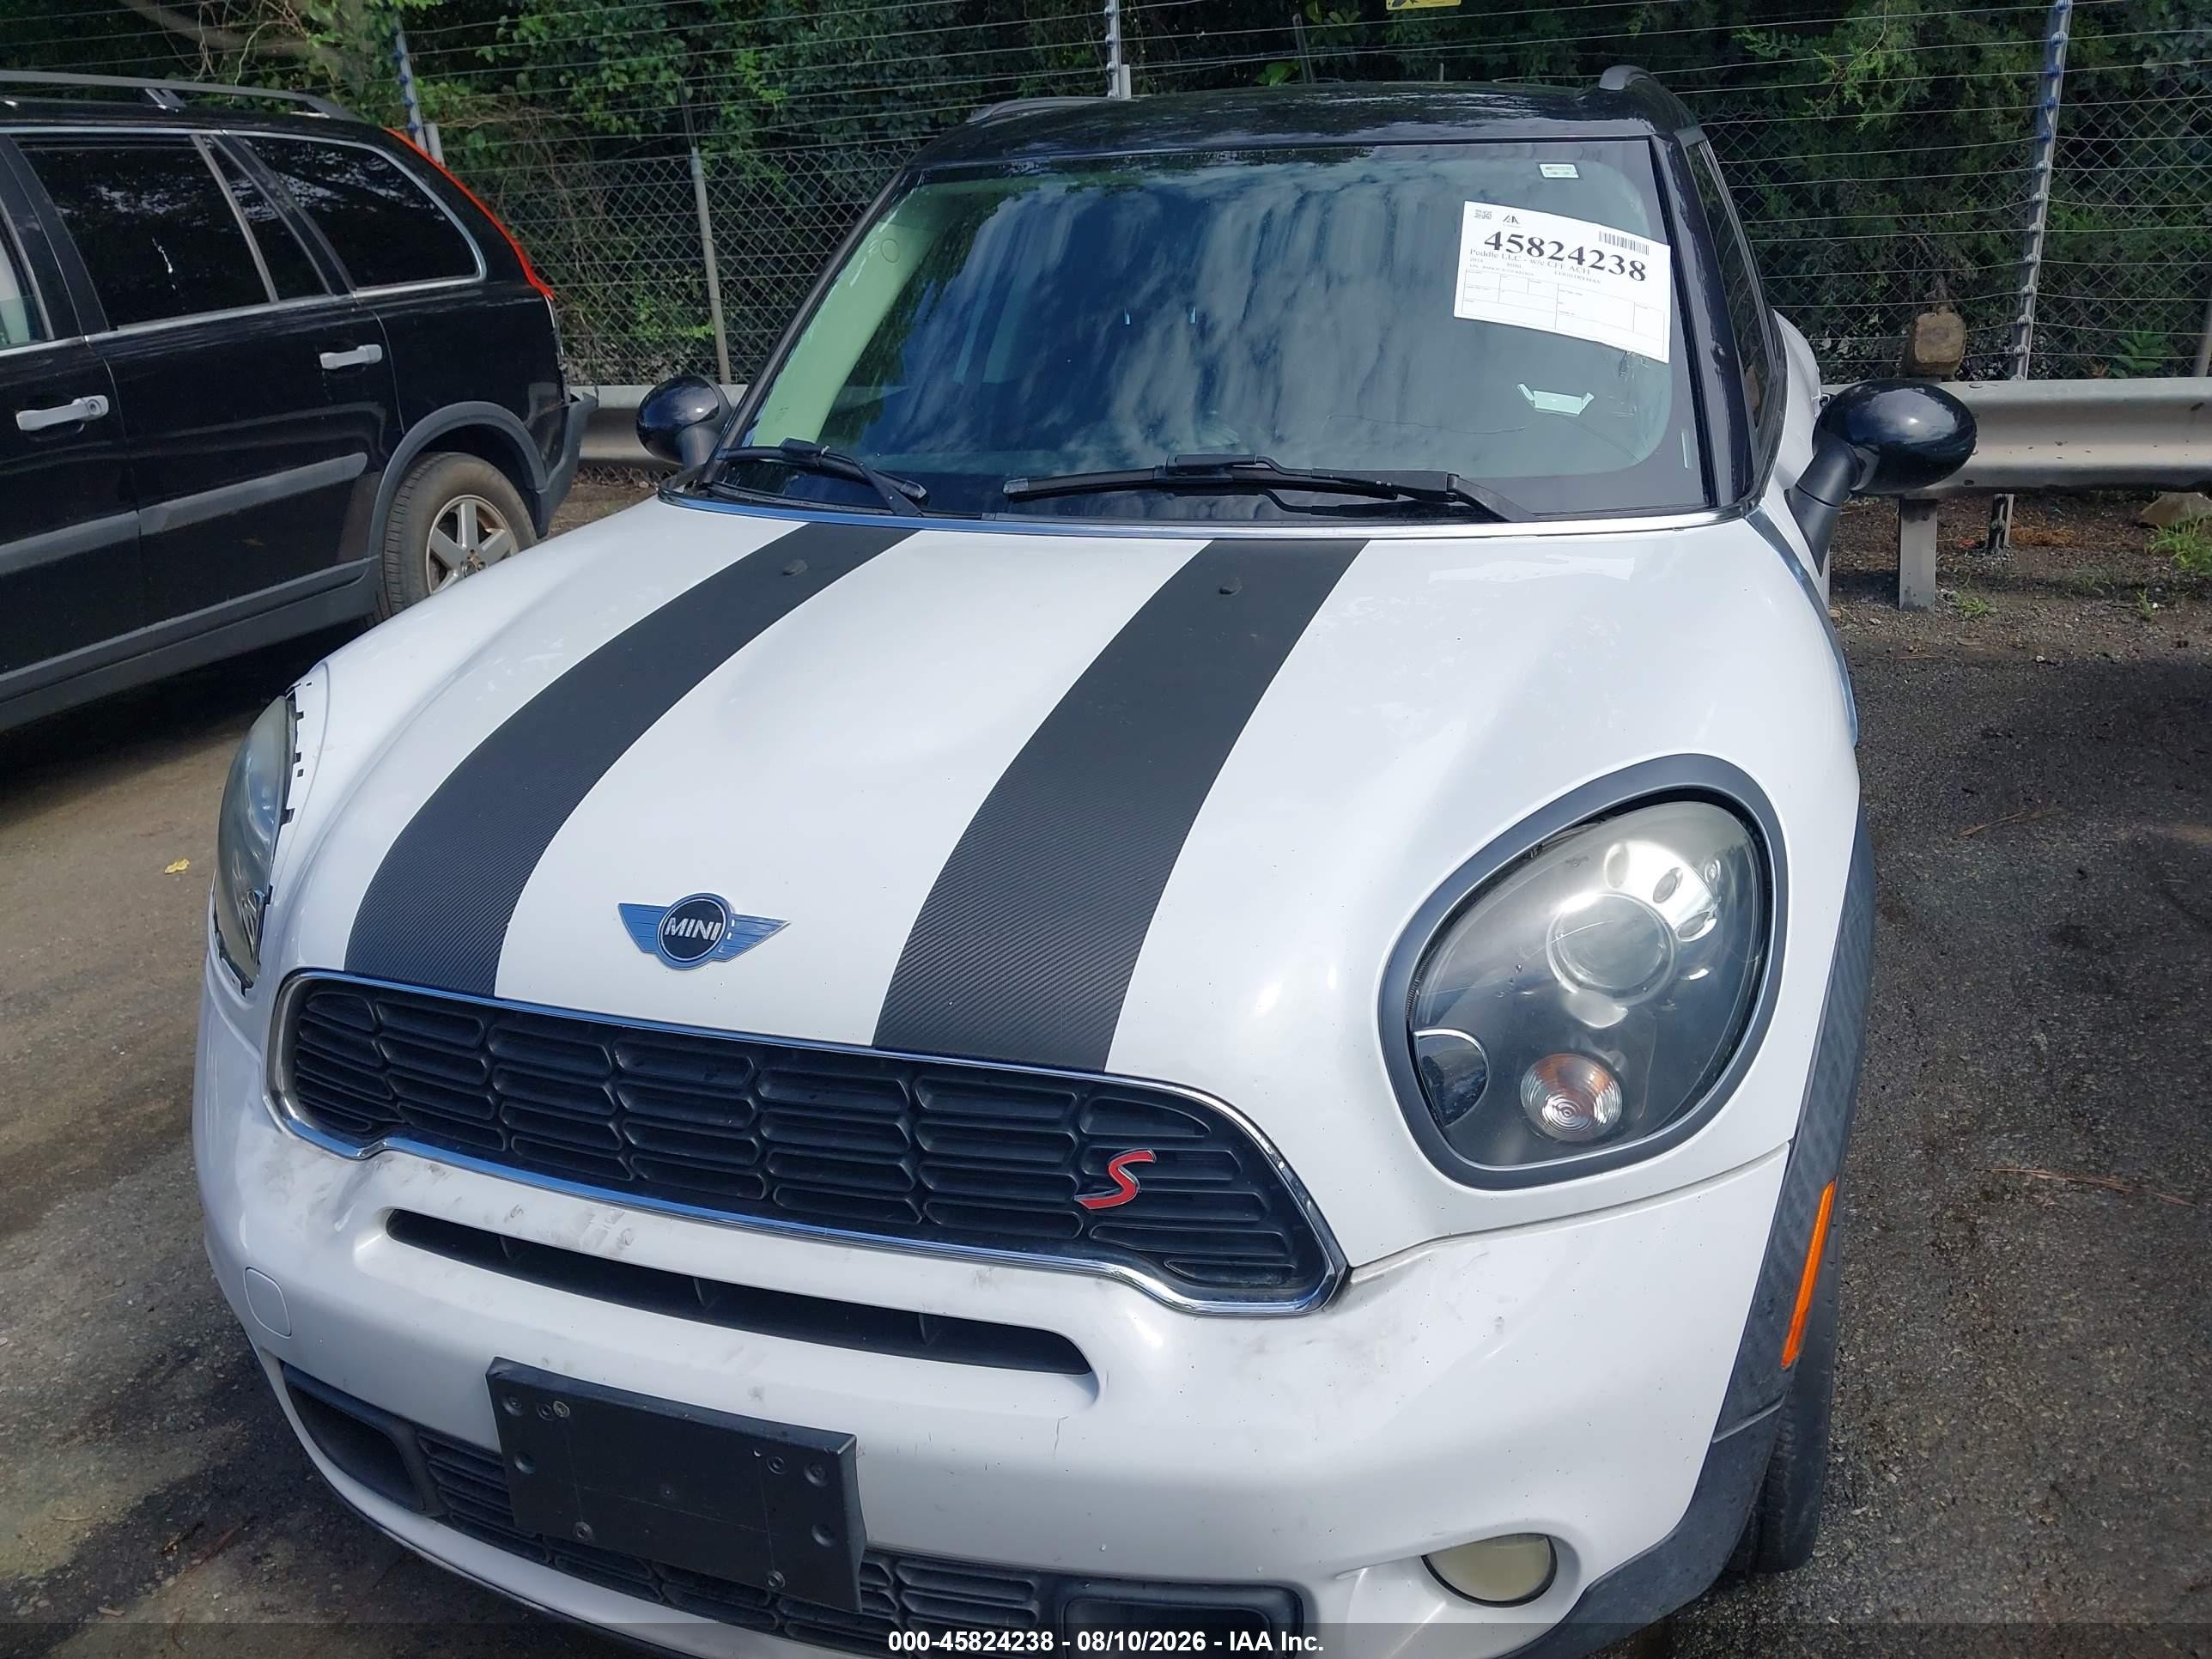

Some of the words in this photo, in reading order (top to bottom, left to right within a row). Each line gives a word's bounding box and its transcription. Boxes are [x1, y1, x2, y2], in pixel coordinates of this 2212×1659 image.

[1484, 231, 1646, 281] 45824238
[664, 916, 722, 941] MINI
[1073, 1148, 1158, 1211] S
